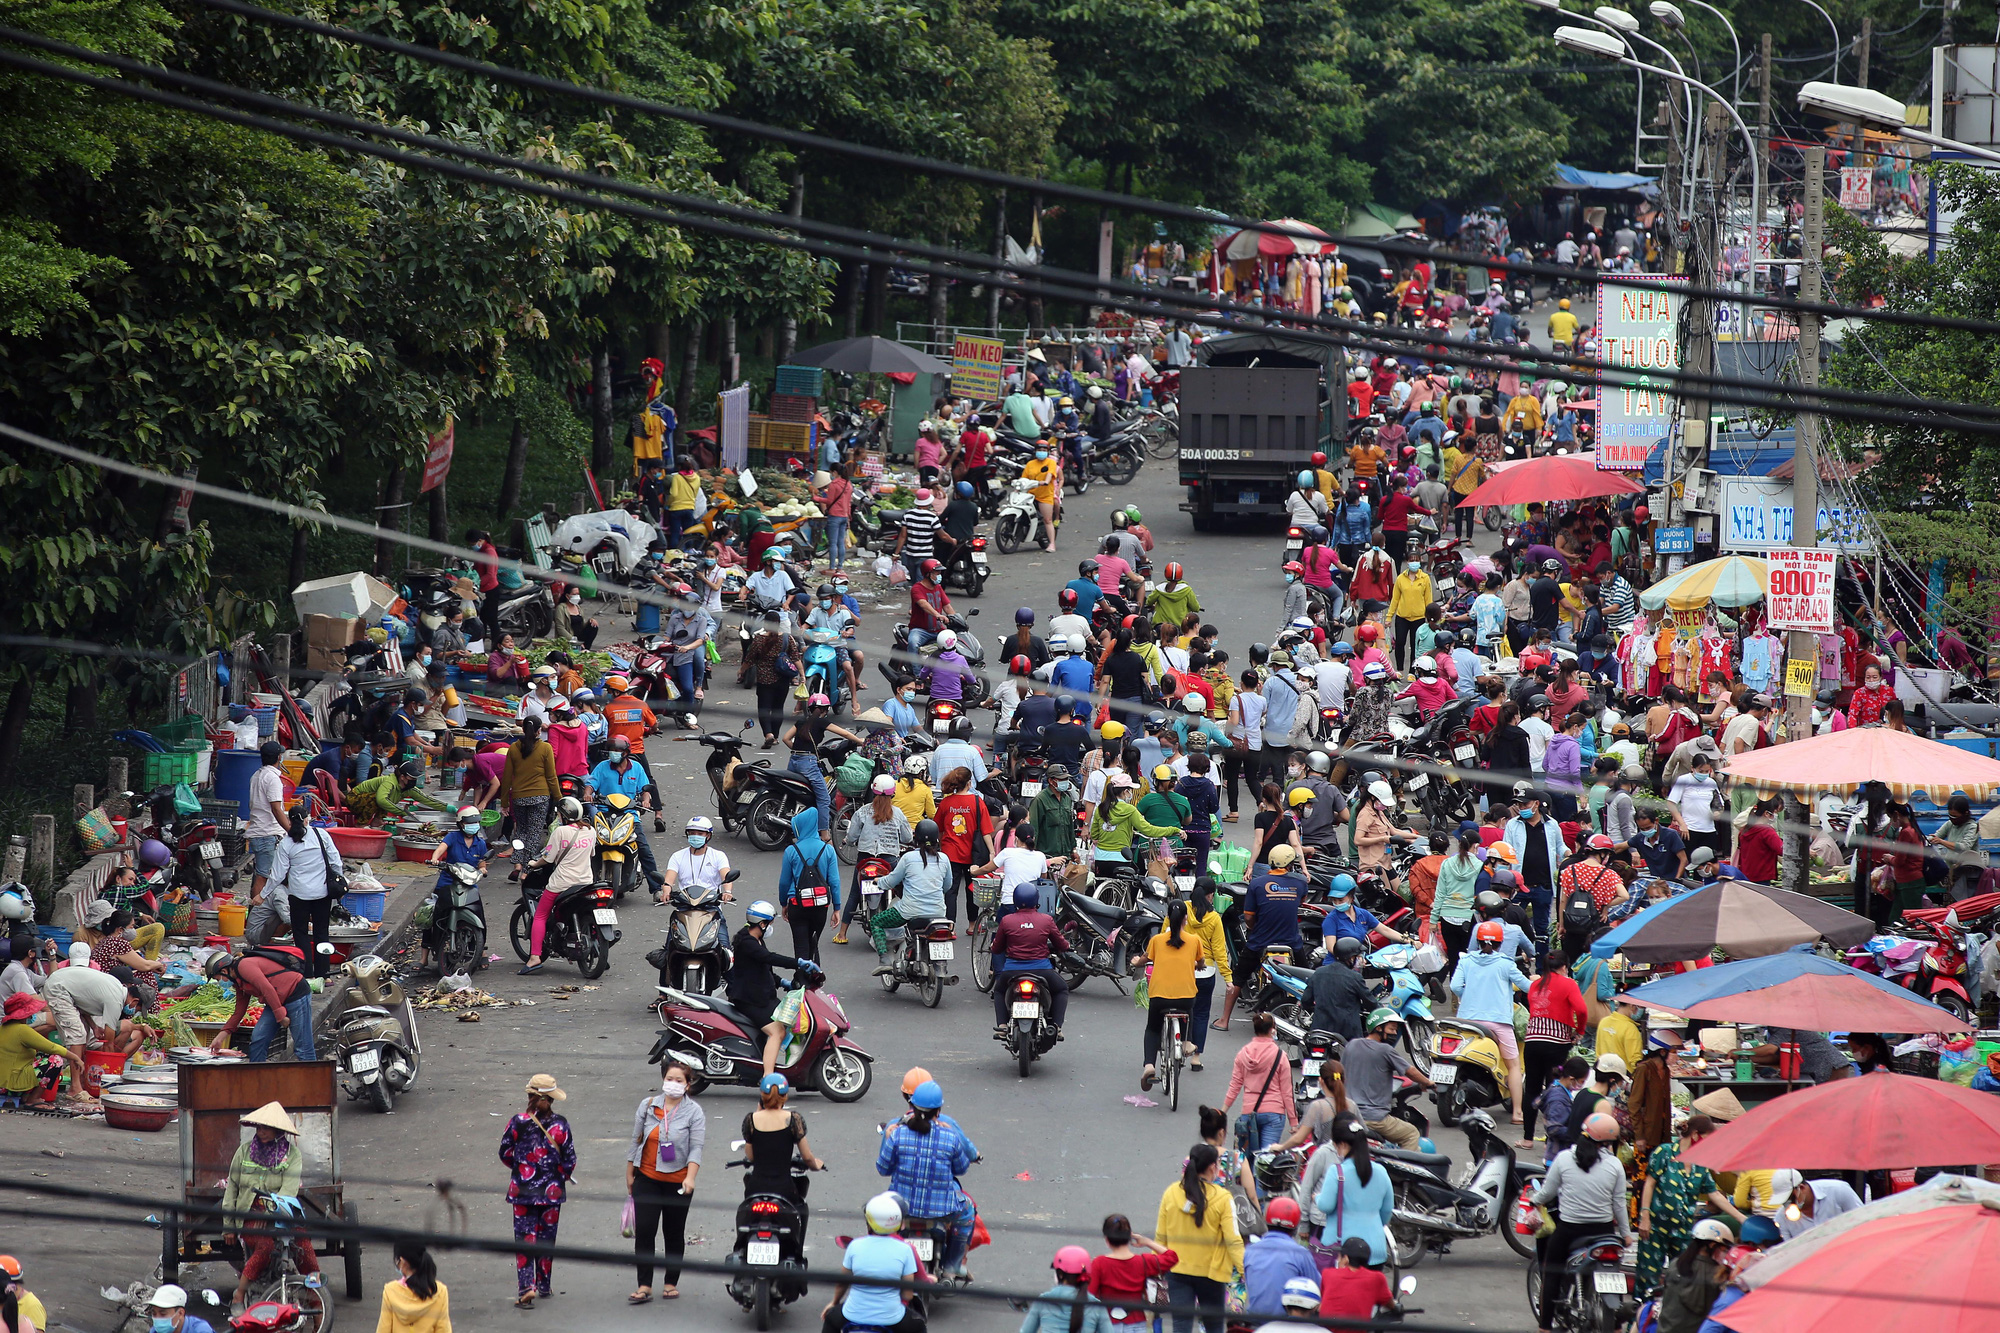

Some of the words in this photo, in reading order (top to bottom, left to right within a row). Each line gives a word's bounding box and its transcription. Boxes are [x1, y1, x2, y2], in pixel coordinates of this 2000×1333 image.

[1621, 281, 1672, 323] NHÀ
[955, 338, 978, 359] DÁN
[980, 344, 1002, 363] KEO
[1620, 375, 1671, 416] TÂY
[1604, 423, 1624, 440] ĐẠT
[1628, 418, 1663, 437] CHUẨN
[1672, 540, 1682, 549] 53
[1770, 570, 1816, 596] 900
[1772, 597, 1829, 622] 0975.462.434
[1793, 667, 1812, 684] 900
[561, 838, 593, 849] DAISY
